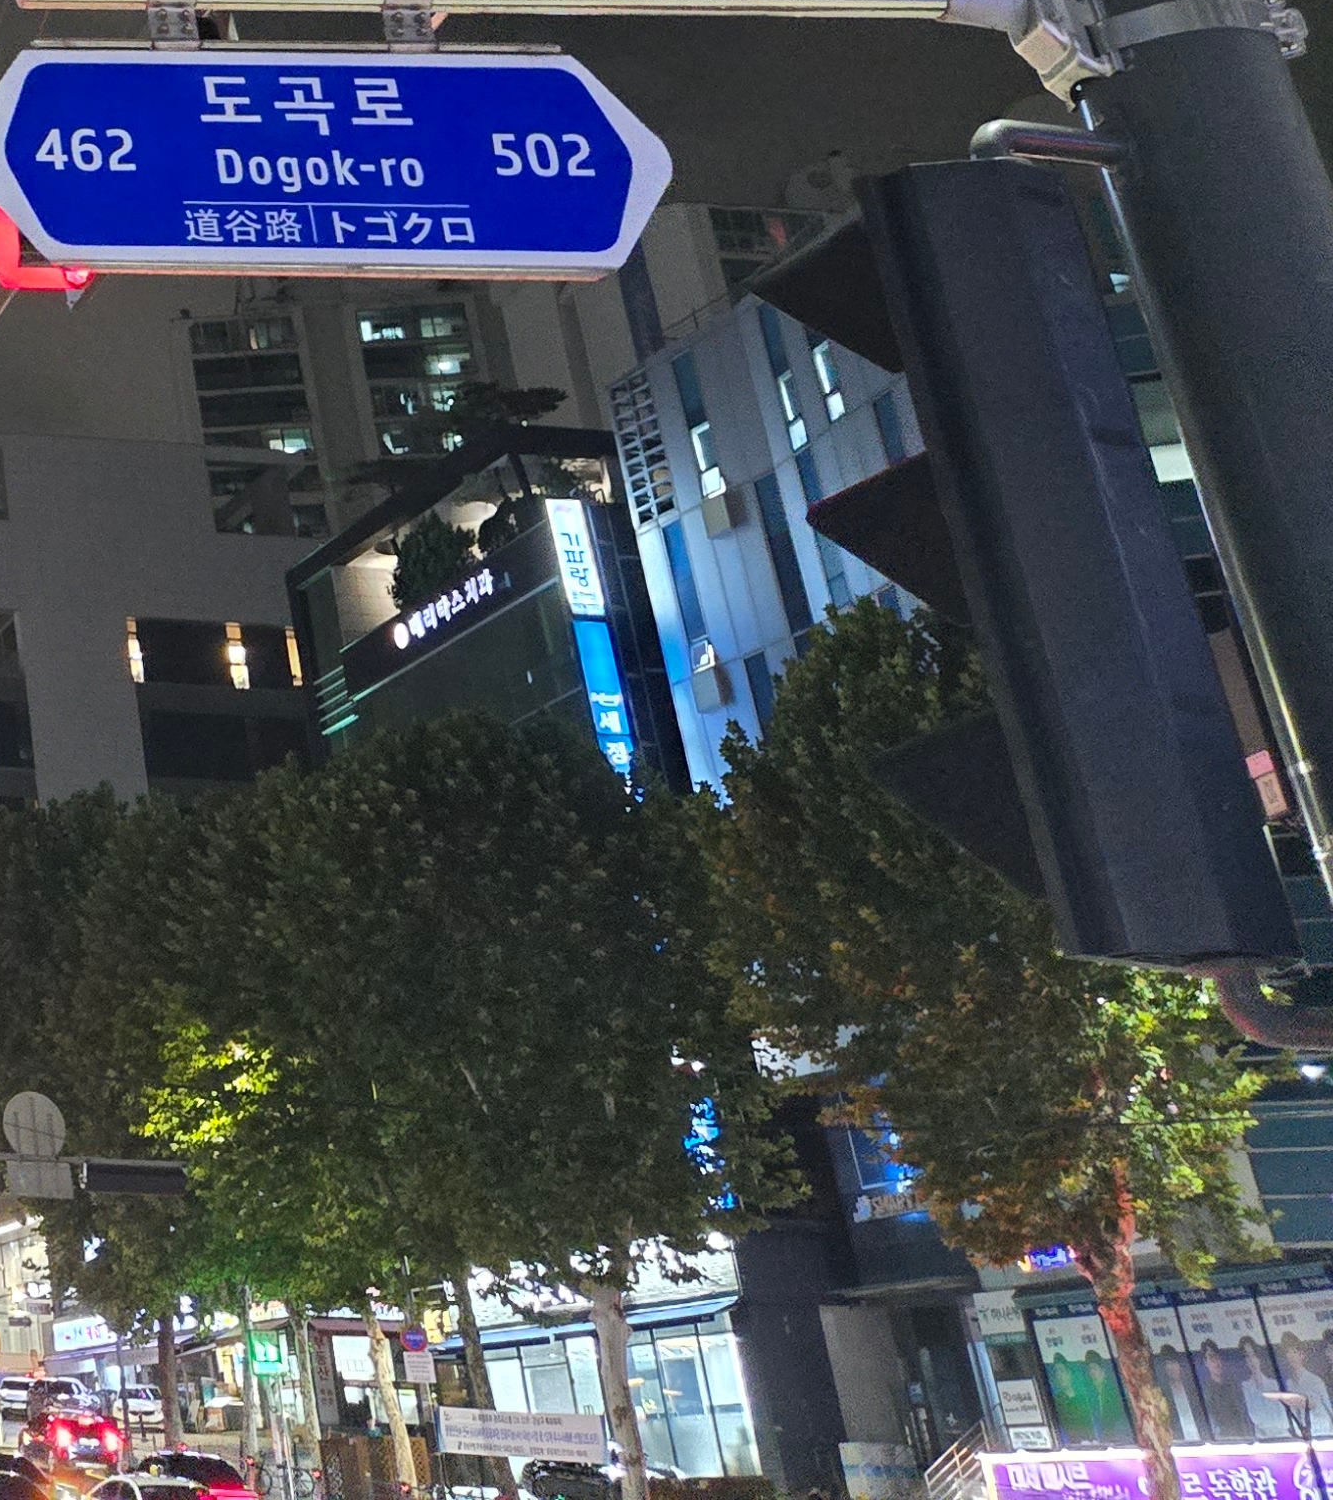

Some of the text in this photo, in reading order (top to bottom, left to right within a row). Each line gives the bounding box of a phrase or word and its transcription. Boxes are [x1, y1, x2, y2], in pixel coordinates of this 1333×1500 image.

[200, 74, 415, 137] 도곡로
[35, 127, 137, 174] 462
[216, 148, 425, 194] Dogok-ro
[492, 131, 595, 179] 502
[184, 208, 303, 245] 道谷路
[329, 208, 476, 245] トゴクロ
[559, 531, 593, 595] 기파랑
